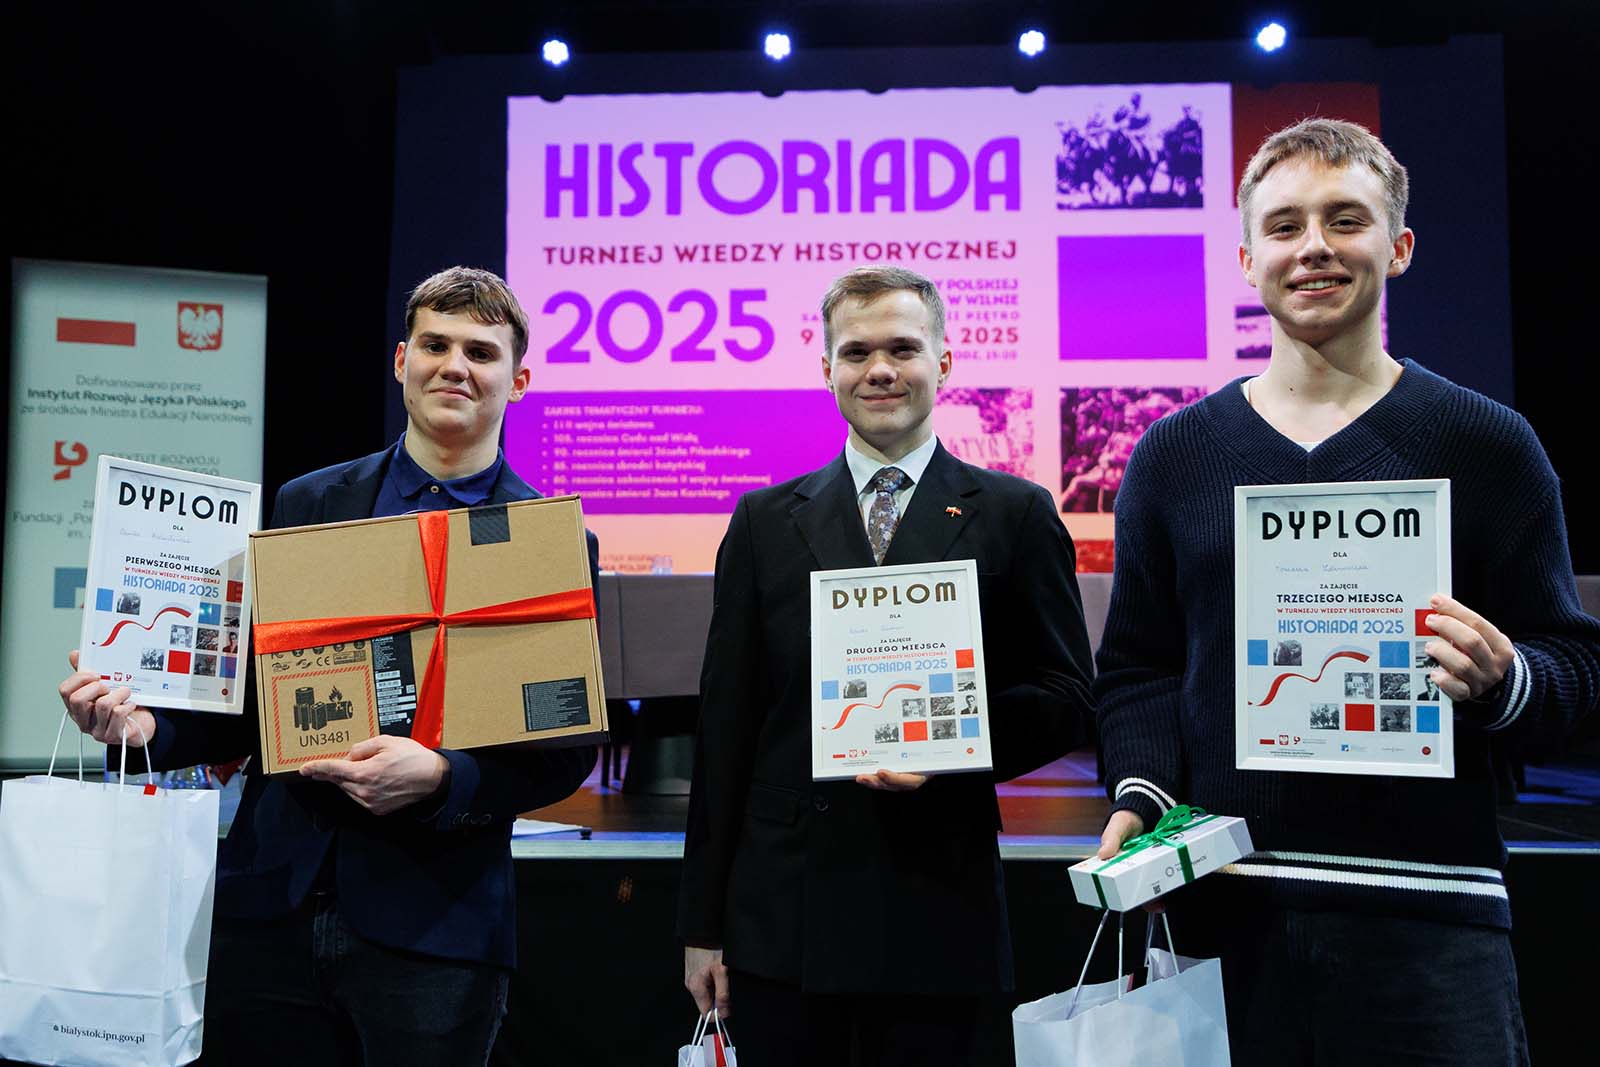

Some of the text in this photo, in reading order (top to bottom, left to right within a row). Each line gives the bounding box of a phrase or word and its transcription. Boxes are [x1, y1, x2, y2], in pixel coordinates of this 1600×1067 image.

[545, 137, 1021, 218] HISTORIADA
[543, 240, 1018, 265] TURNIEJ WIEDZY HISTORYCZNEJ
[946, 278, 1019, 290] POLSKIEJ
[947, 294, 1018, 306] W WILNIE
[542, 289, 775, 364] 2025
[800, 328, 815, 345] 9
[961, 326, 1019, 344] 2025
[28, 388, 246, 408] Instytut Rozwoju Języka Polskiego
[119, 481, 239, 525] DYPLOM
[172, 524, 184, 532] DLA
[1262, 508, 1420, 540] DYPLOM
[125, 555, 221, 577] PIERWSZEGO MIEJSCA
[168, 553, 190, 562] ZAJĘCIE
[123, 574, 219, 599] HISTORIADA 2025
[832, 581, 957, 610] DYPLOM
[1276, 593, 1404, 604] TRZECIEGO MIEJSCA
[1278, 619, 1405, 635] HISTORIADA 2025
[846, 642, 947, 655] DRUGIEGO MIEJSCA
[847, 658, 948, 676] HISTORIADA 2025
[300, 730, 350, 748] UN3481
